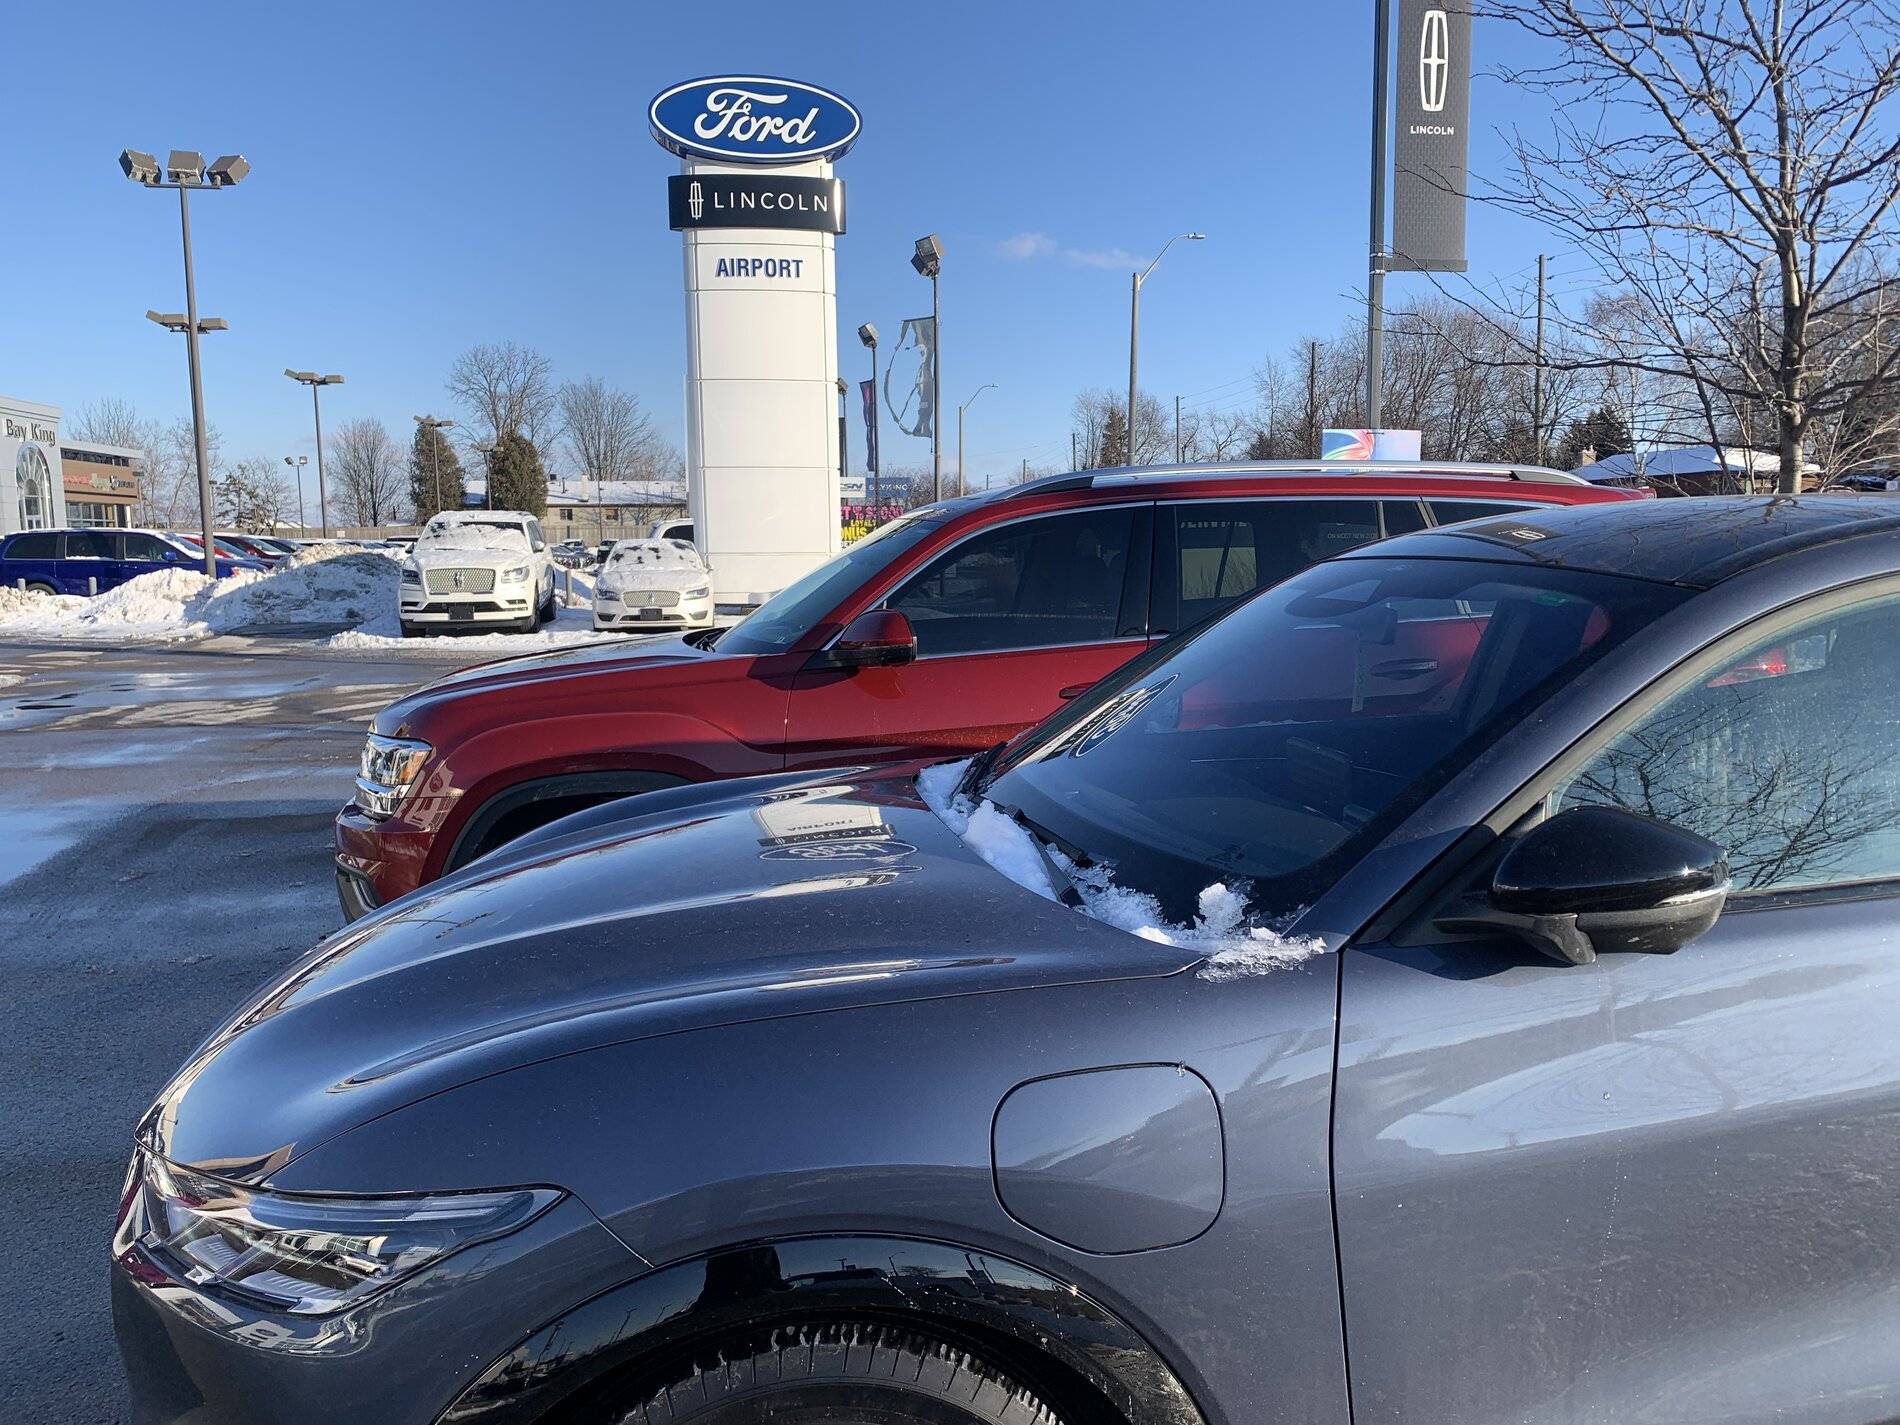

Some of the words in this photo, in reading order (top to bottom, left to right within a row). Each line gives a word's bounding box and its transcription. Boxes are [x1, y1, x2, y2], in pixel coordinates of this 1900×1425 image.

[693, 88, 820, 145] Ford
[1410, 125, 1455, 135] LINCOLN
[714, 191, 829, 213] LINCOLN
[714, 257, 804, 279] AIRPORT
[6, 419, 27, 441] Bay
[31, 422, 56, 447] King
